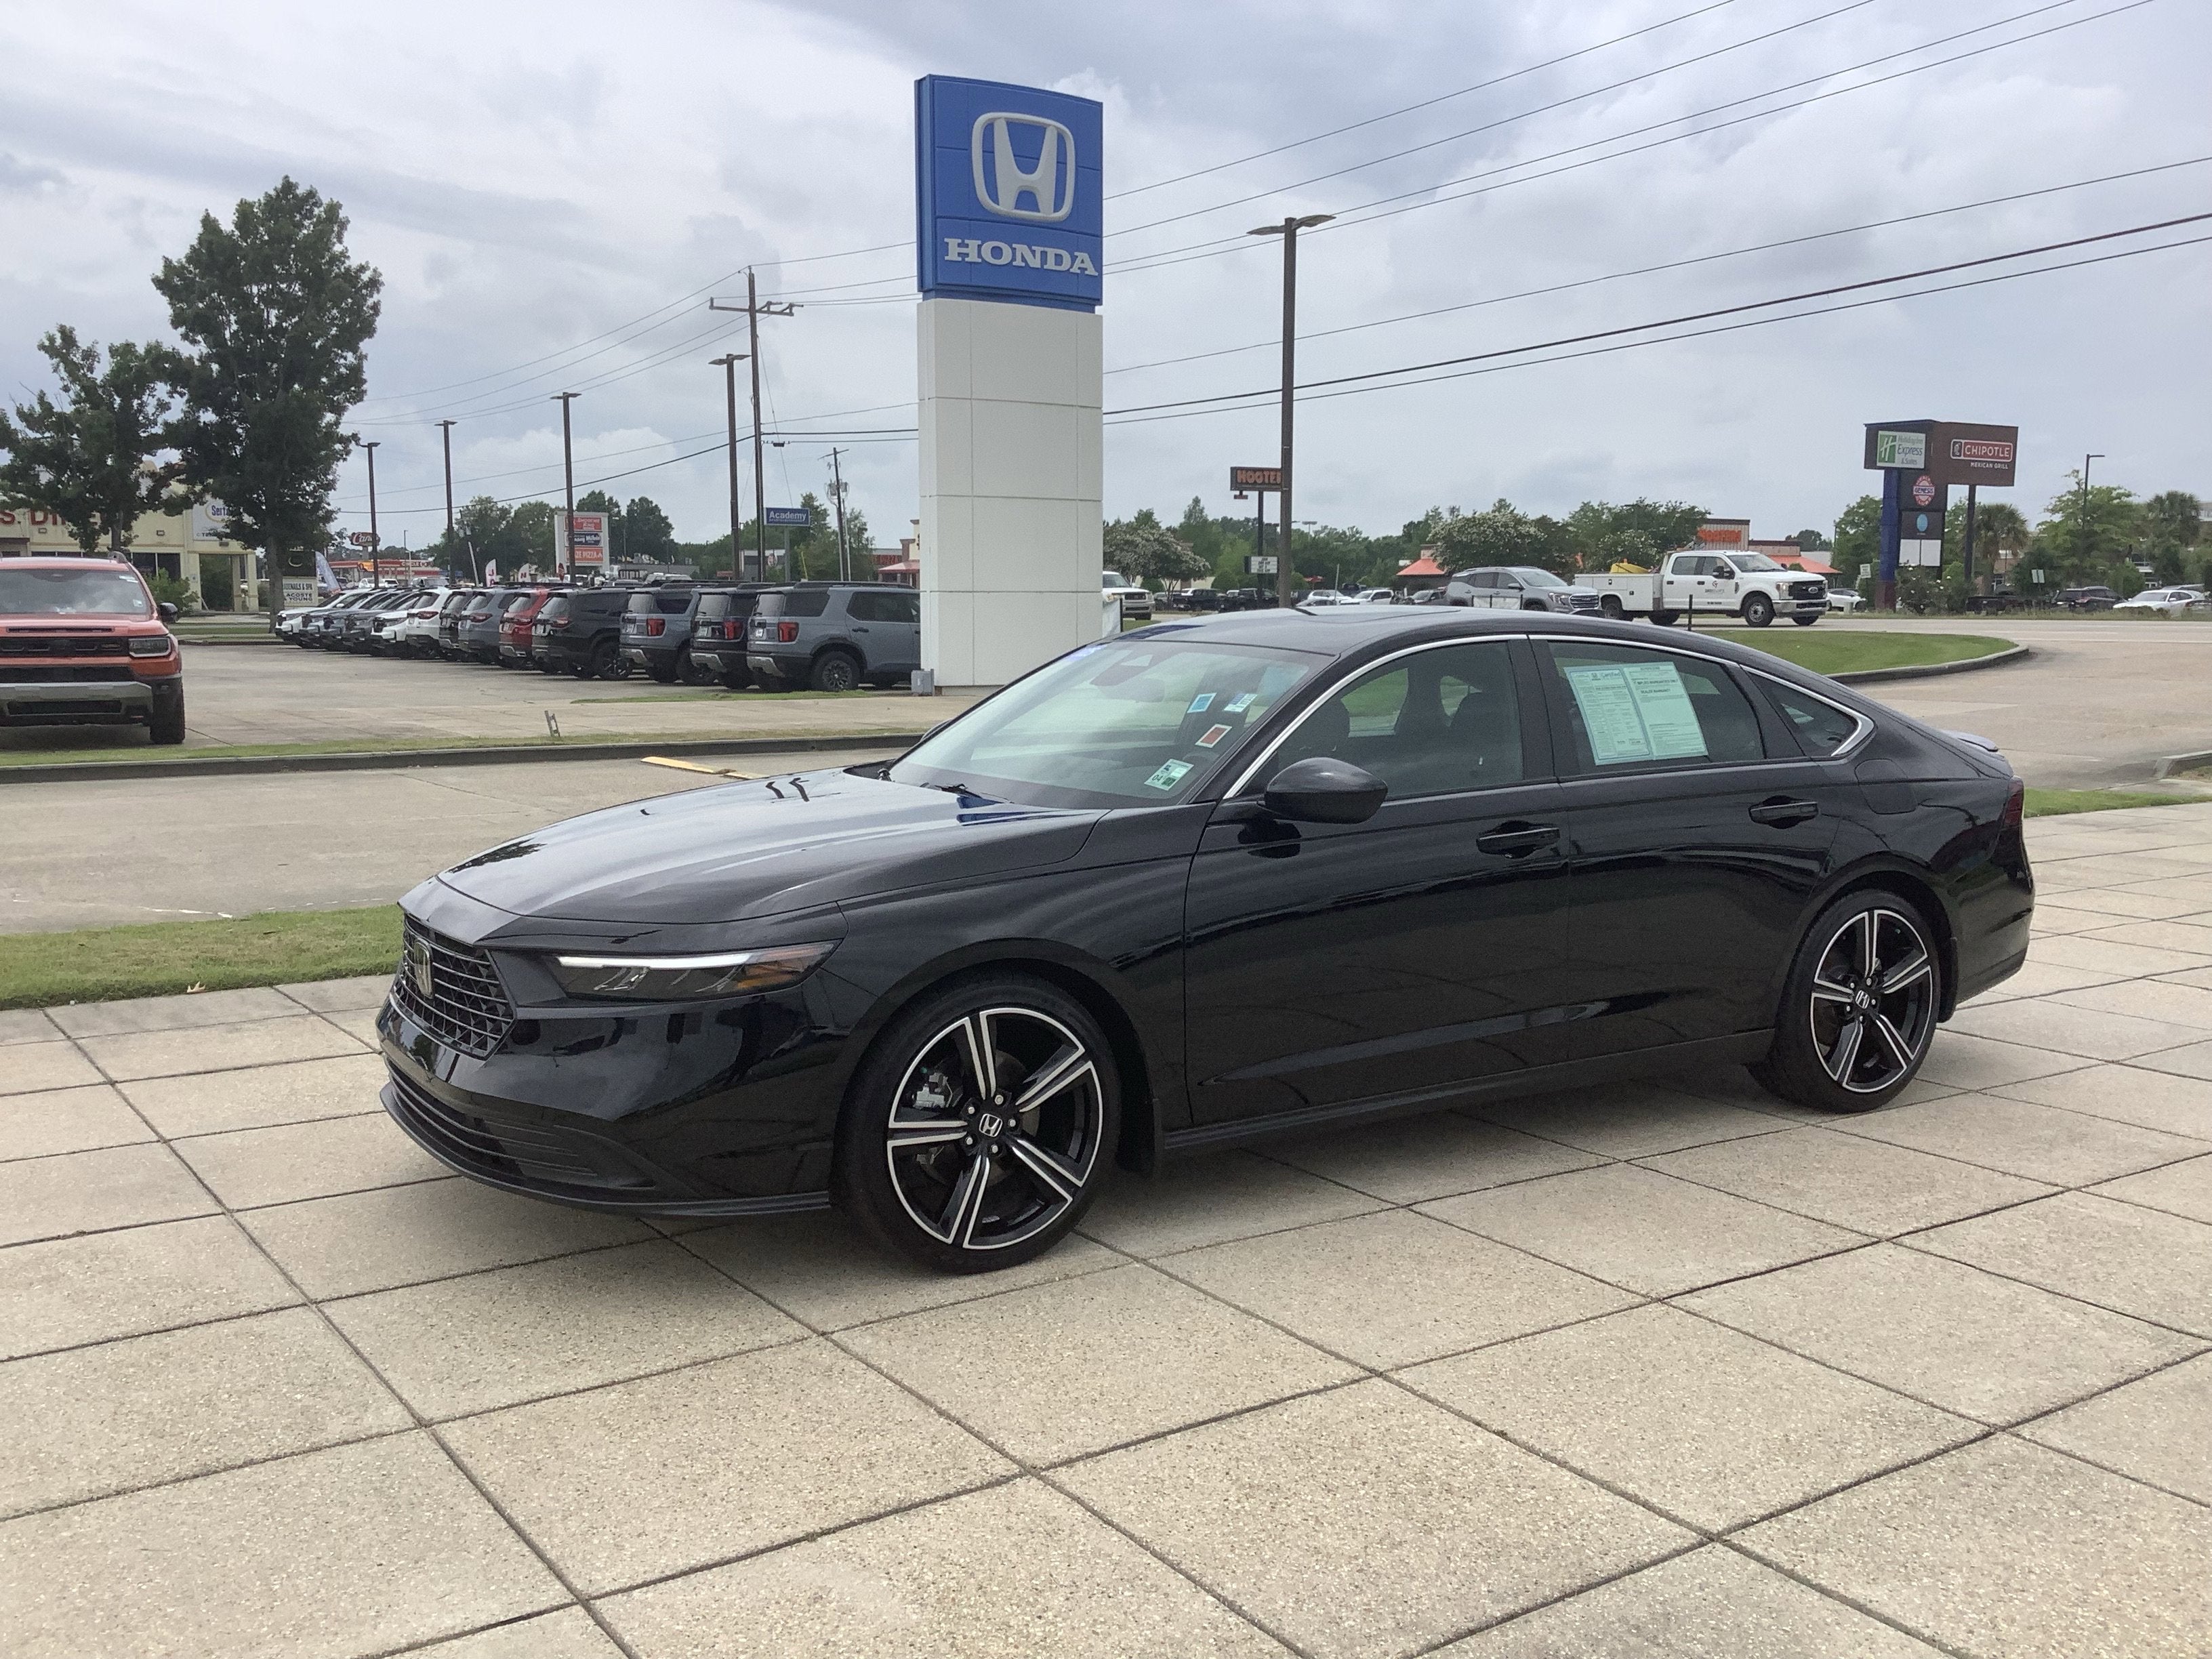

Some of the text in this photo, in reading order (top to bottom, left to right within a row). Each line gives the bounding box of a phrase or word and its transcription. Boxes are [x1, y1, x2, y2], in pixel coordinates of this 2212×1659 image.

[944, 238, 1099, 276] HONDA
[1898, 445, 1923, 457] Express
[1965, 445, 2010, 457] CHIPOTLE
[769, 510, 806, 521] Academy
[352, 533, 378, 545] Can
